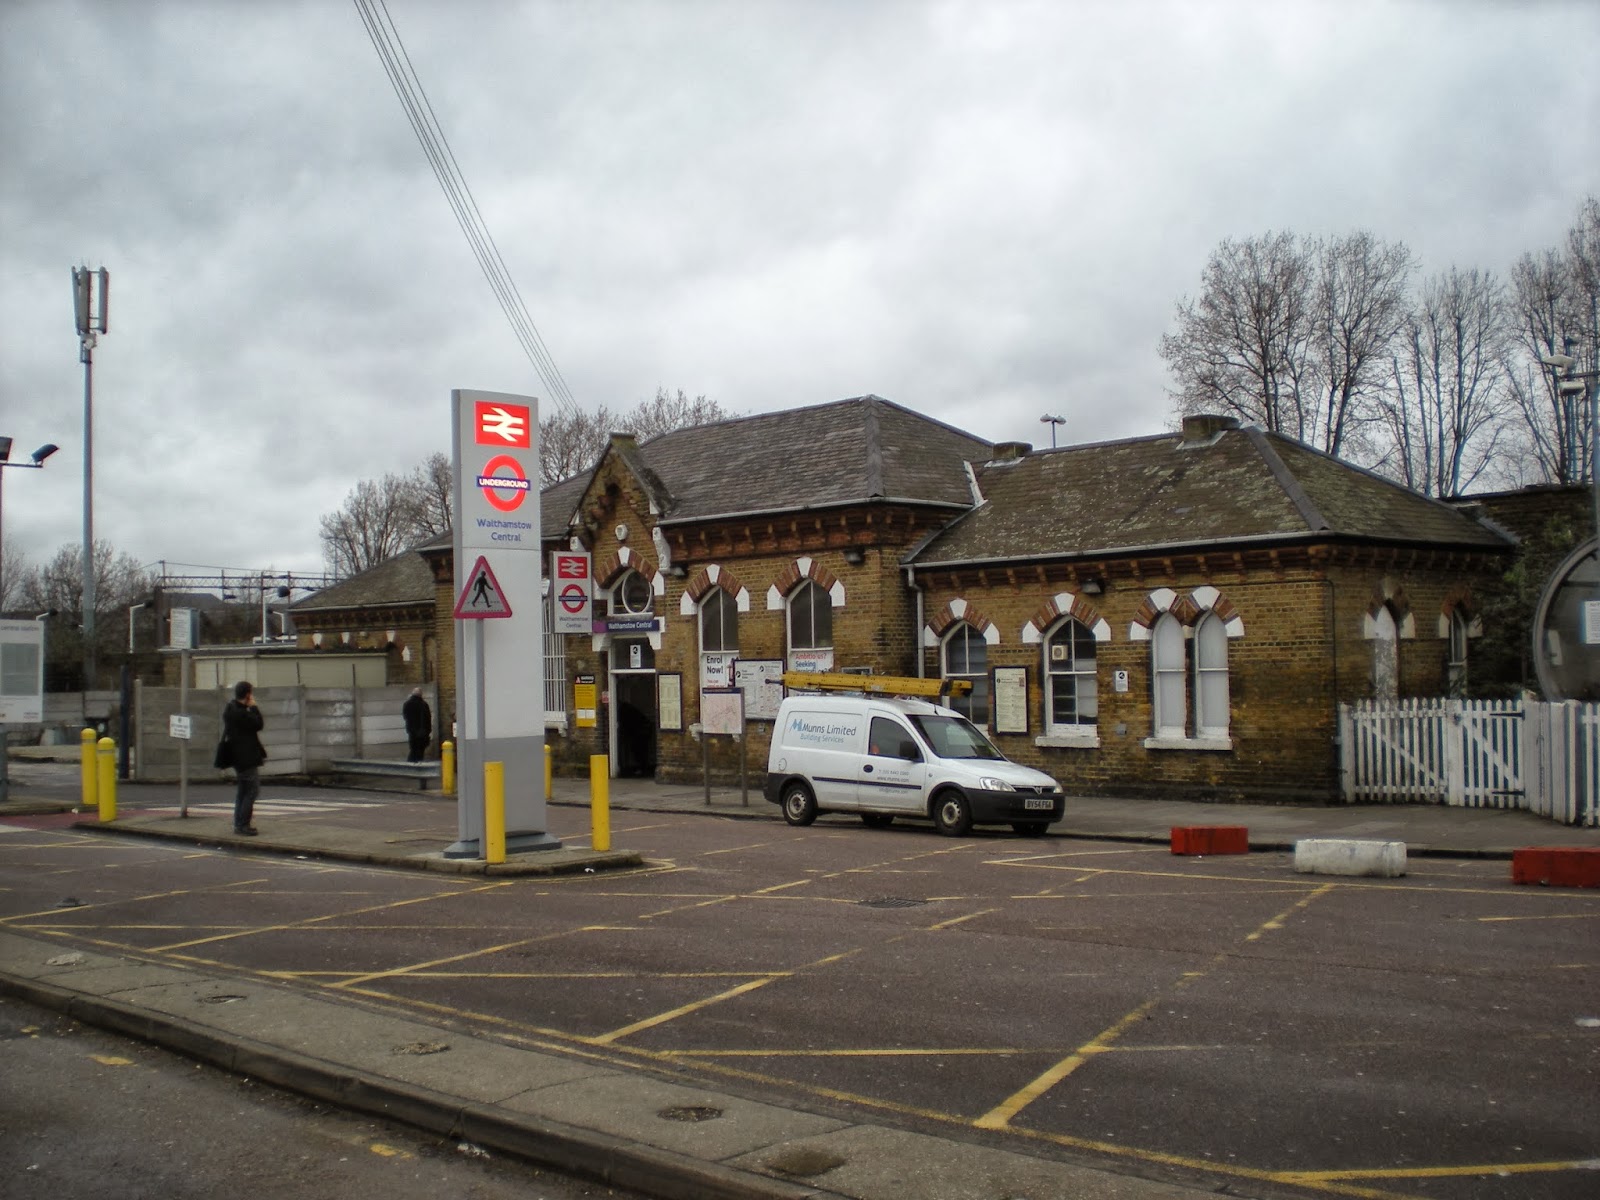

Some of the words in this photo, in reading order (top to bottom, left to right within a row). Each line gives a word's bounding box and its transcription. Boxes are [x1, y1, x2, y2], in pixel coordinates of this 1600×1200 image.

[478, 478, 529, 489] UNDERGROUND
[476, 518, 532, 530] Walthamstow
[490, 531, 521, 542] Central
[608, 622, 635, 630] Walthamstow
[636, 621, 653, 629] Central
[706, 655, 723, 664] Enrol
[795, 660, 816, 669] Seeking
[706, 665, 723, 674] Now!
[802, 723, 826, 734] Munns
[826, 724, 857, 736] Limited
[800, 733, 821, 742] Building
[822, 734, 844, 743] Services
